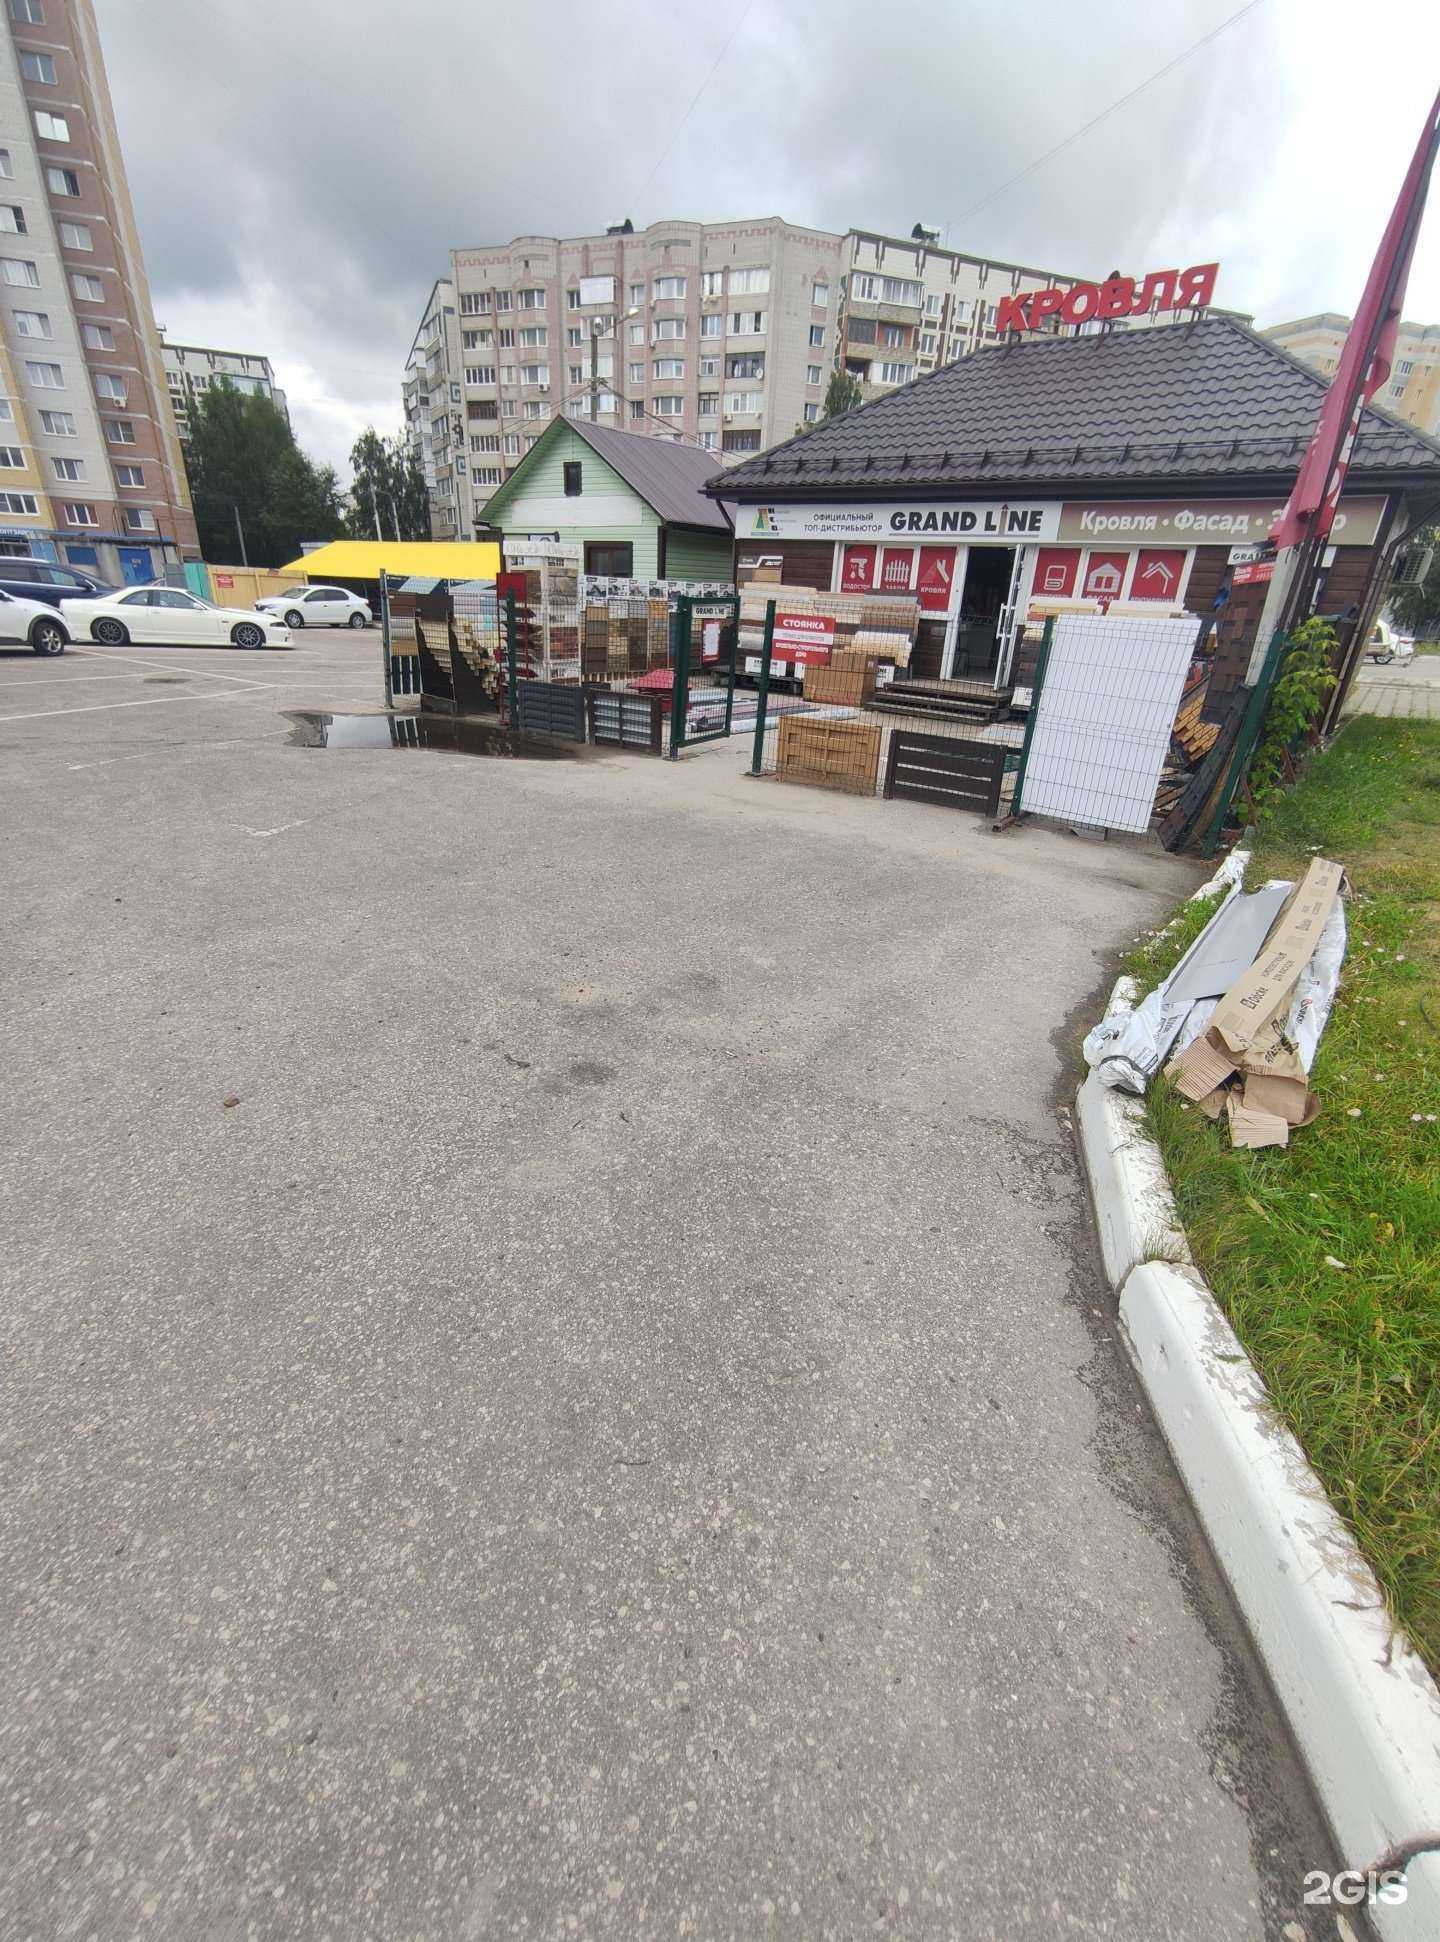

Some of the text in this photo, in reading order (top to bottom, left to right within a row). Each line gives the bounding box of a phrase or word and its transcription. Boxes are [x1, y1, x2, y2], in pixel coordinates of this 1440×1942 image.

[996, 263, 1219, 332] КРОВЛЯ
[813, 512, 874, 522] ОФИЦИАЛЬНЫЙ
[889, 511, 978, 532] GRAND
[1079, 511, 1157, 537] Кровля
[1173, 509, 1249, 534] Фасад
[804, 524, 882, 533] ТОП-ДИСТРИБЬЮТОР
[783, 619, 825, 630] СТОЯНКА
